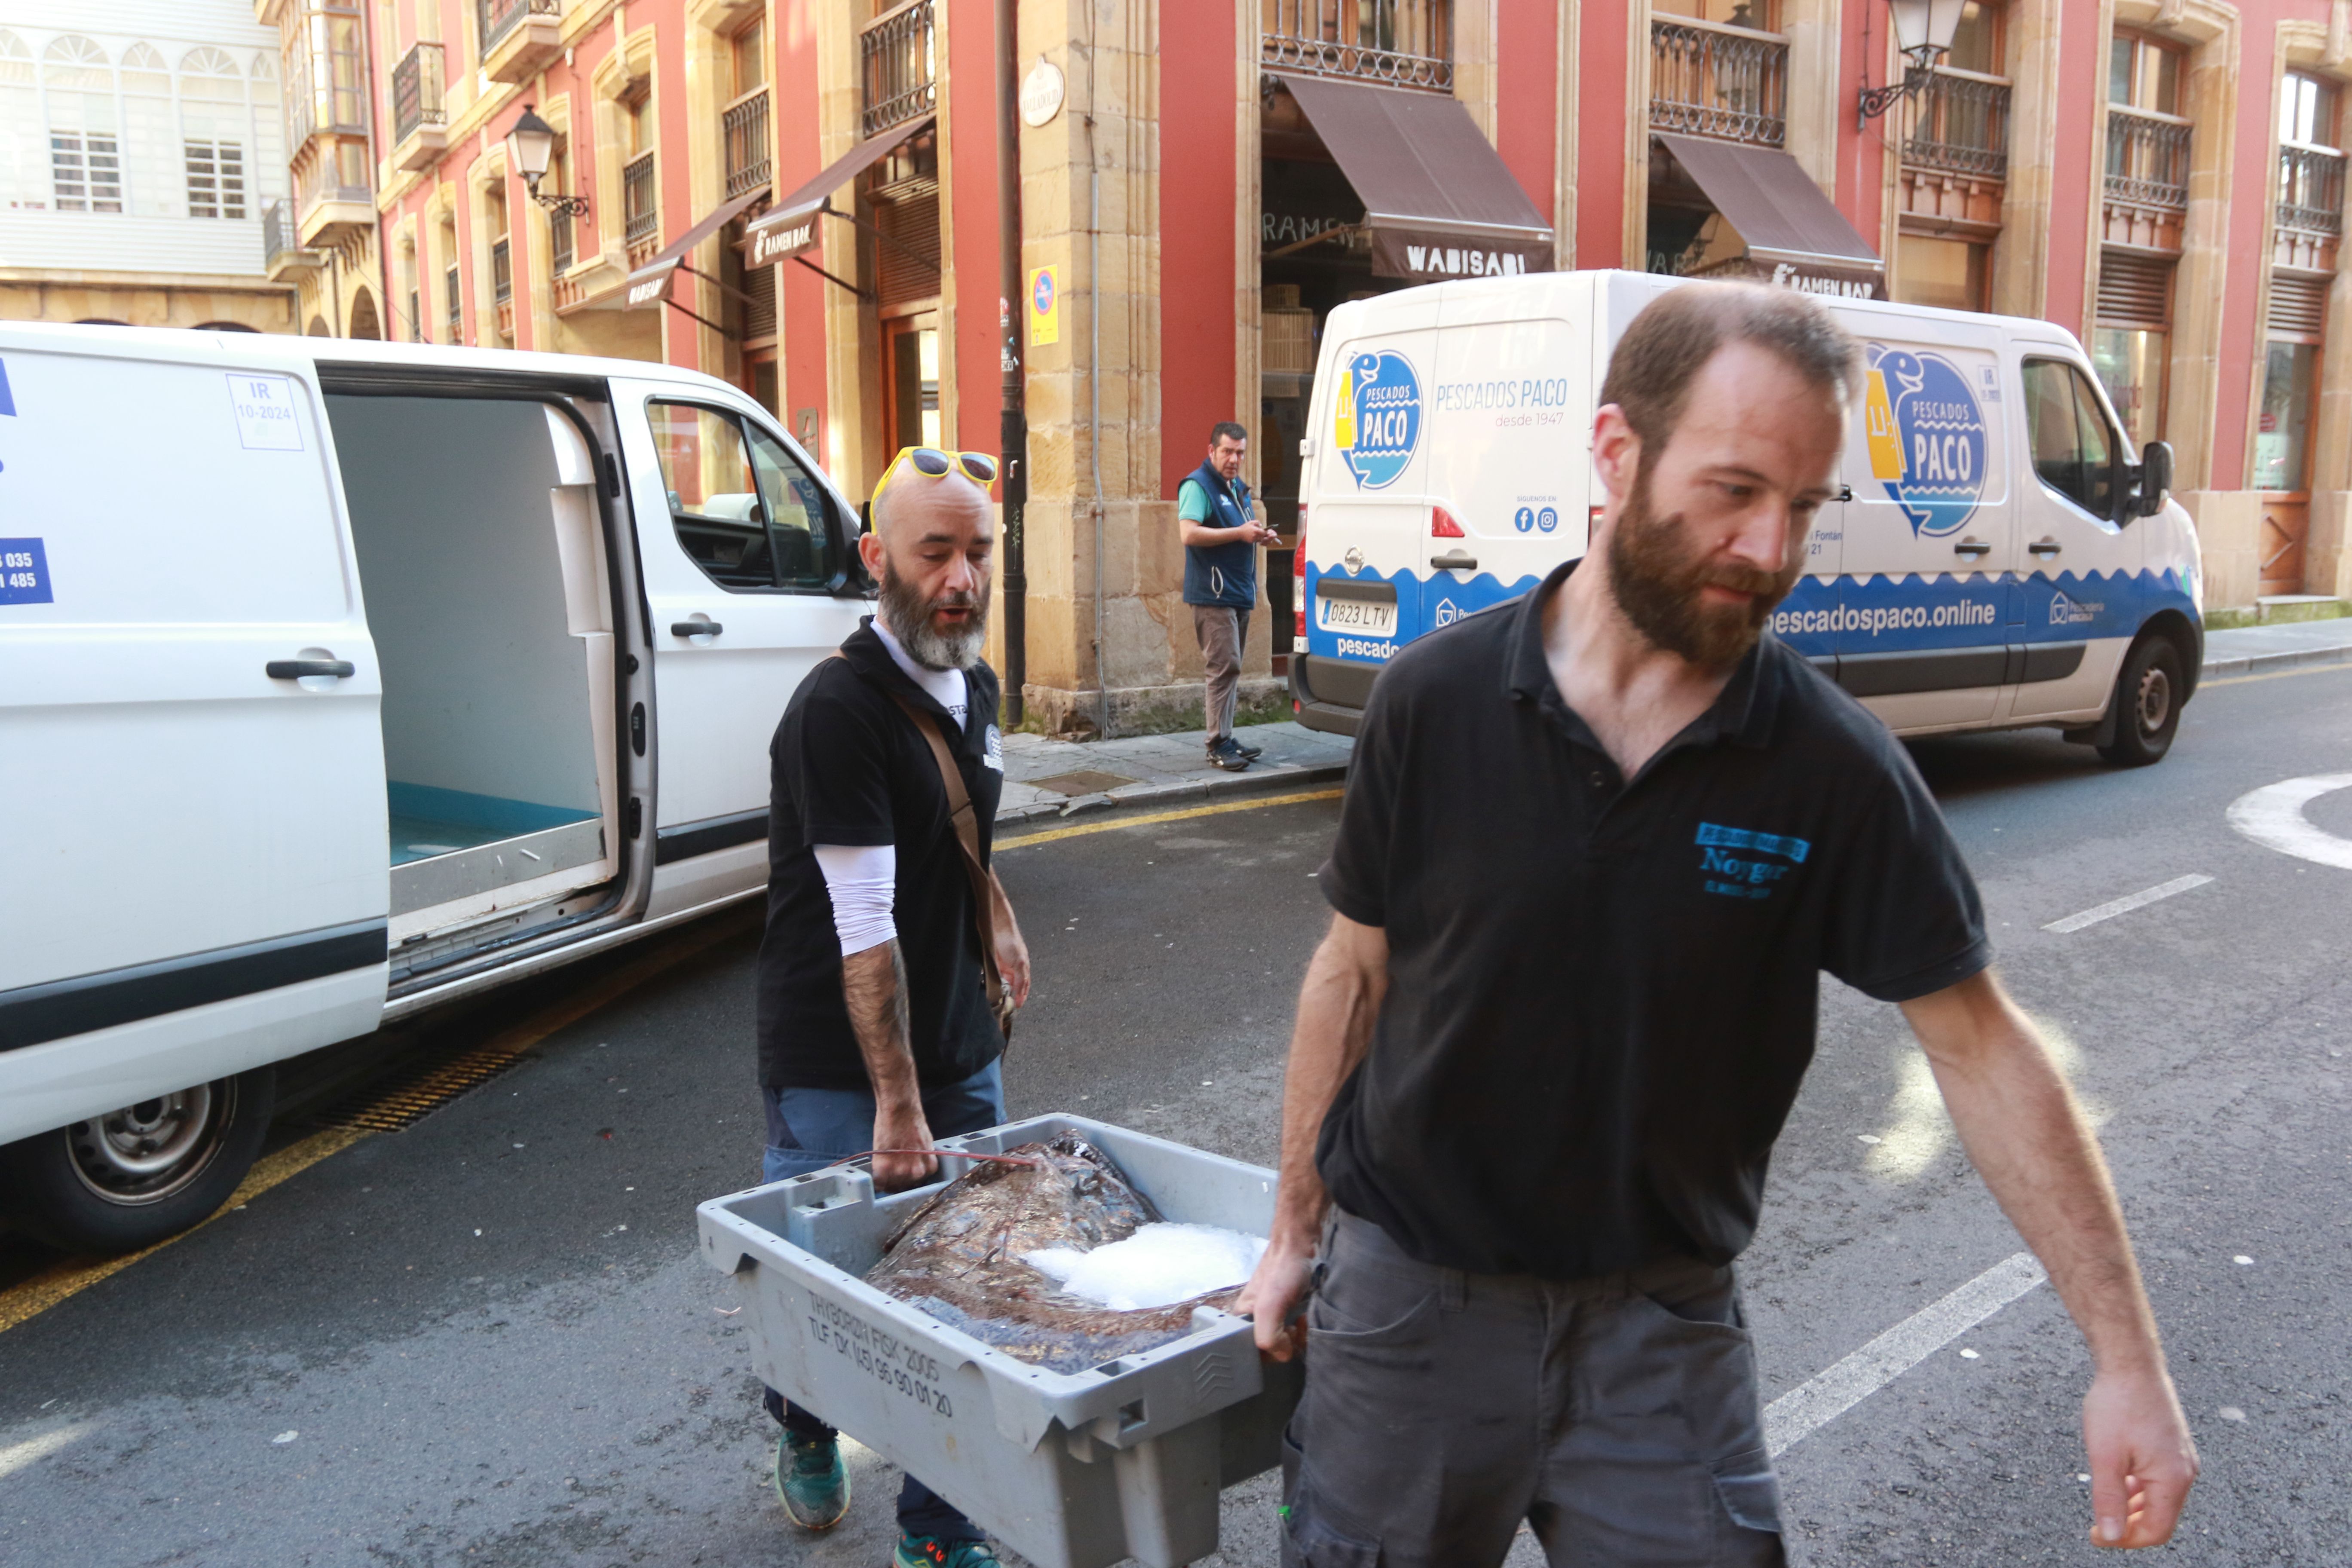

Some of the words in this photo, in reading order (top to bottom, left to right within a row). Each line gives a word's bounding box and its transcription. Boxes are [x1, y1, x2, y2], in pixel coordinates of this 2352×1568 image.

[766, 230, 793, 255] RAMEN
[793, 224, 811, 248] BAR
[1406, 245, 1525, 276] WABISABI
[1790, 275, 1840, 296] RAMEN
[249, 382, 271, 399] IR
[1366, 385, 1410, 401] PESCADOS
[1436, 380, 1517, 411] PESCADOS
[1521, 378, 1568, 407] PACO
[238, 404, 291, 420] 10-2024
[1495, 413, 1532, 427] desde
[1536, 412, 1564, 426] 1947
[1913, 401, 1969, 420] PESCADOS
[1363, 410, 1408, 447] PACO
[1914, 433, 1972, 481] PACO
[6, 552, 33, 567] 035
[1811, 544, 1822, 554] 21
[9, 573, 36, 588] 485
[1331, 604, 1360, 623] 0823
[1363, 606, 1390, 626] LTV
[871, 1326, 902, 1363] FISK
[904, 1345, 940, 1382] 2005
[834, 1331, 852, 1359] DK
[875, 1357, 892, 1384] 96
[894, 1369, 913, 1396] 90
[915, 1380, 931, 1406] 01
[933, 1389, 952, 1418] 20
